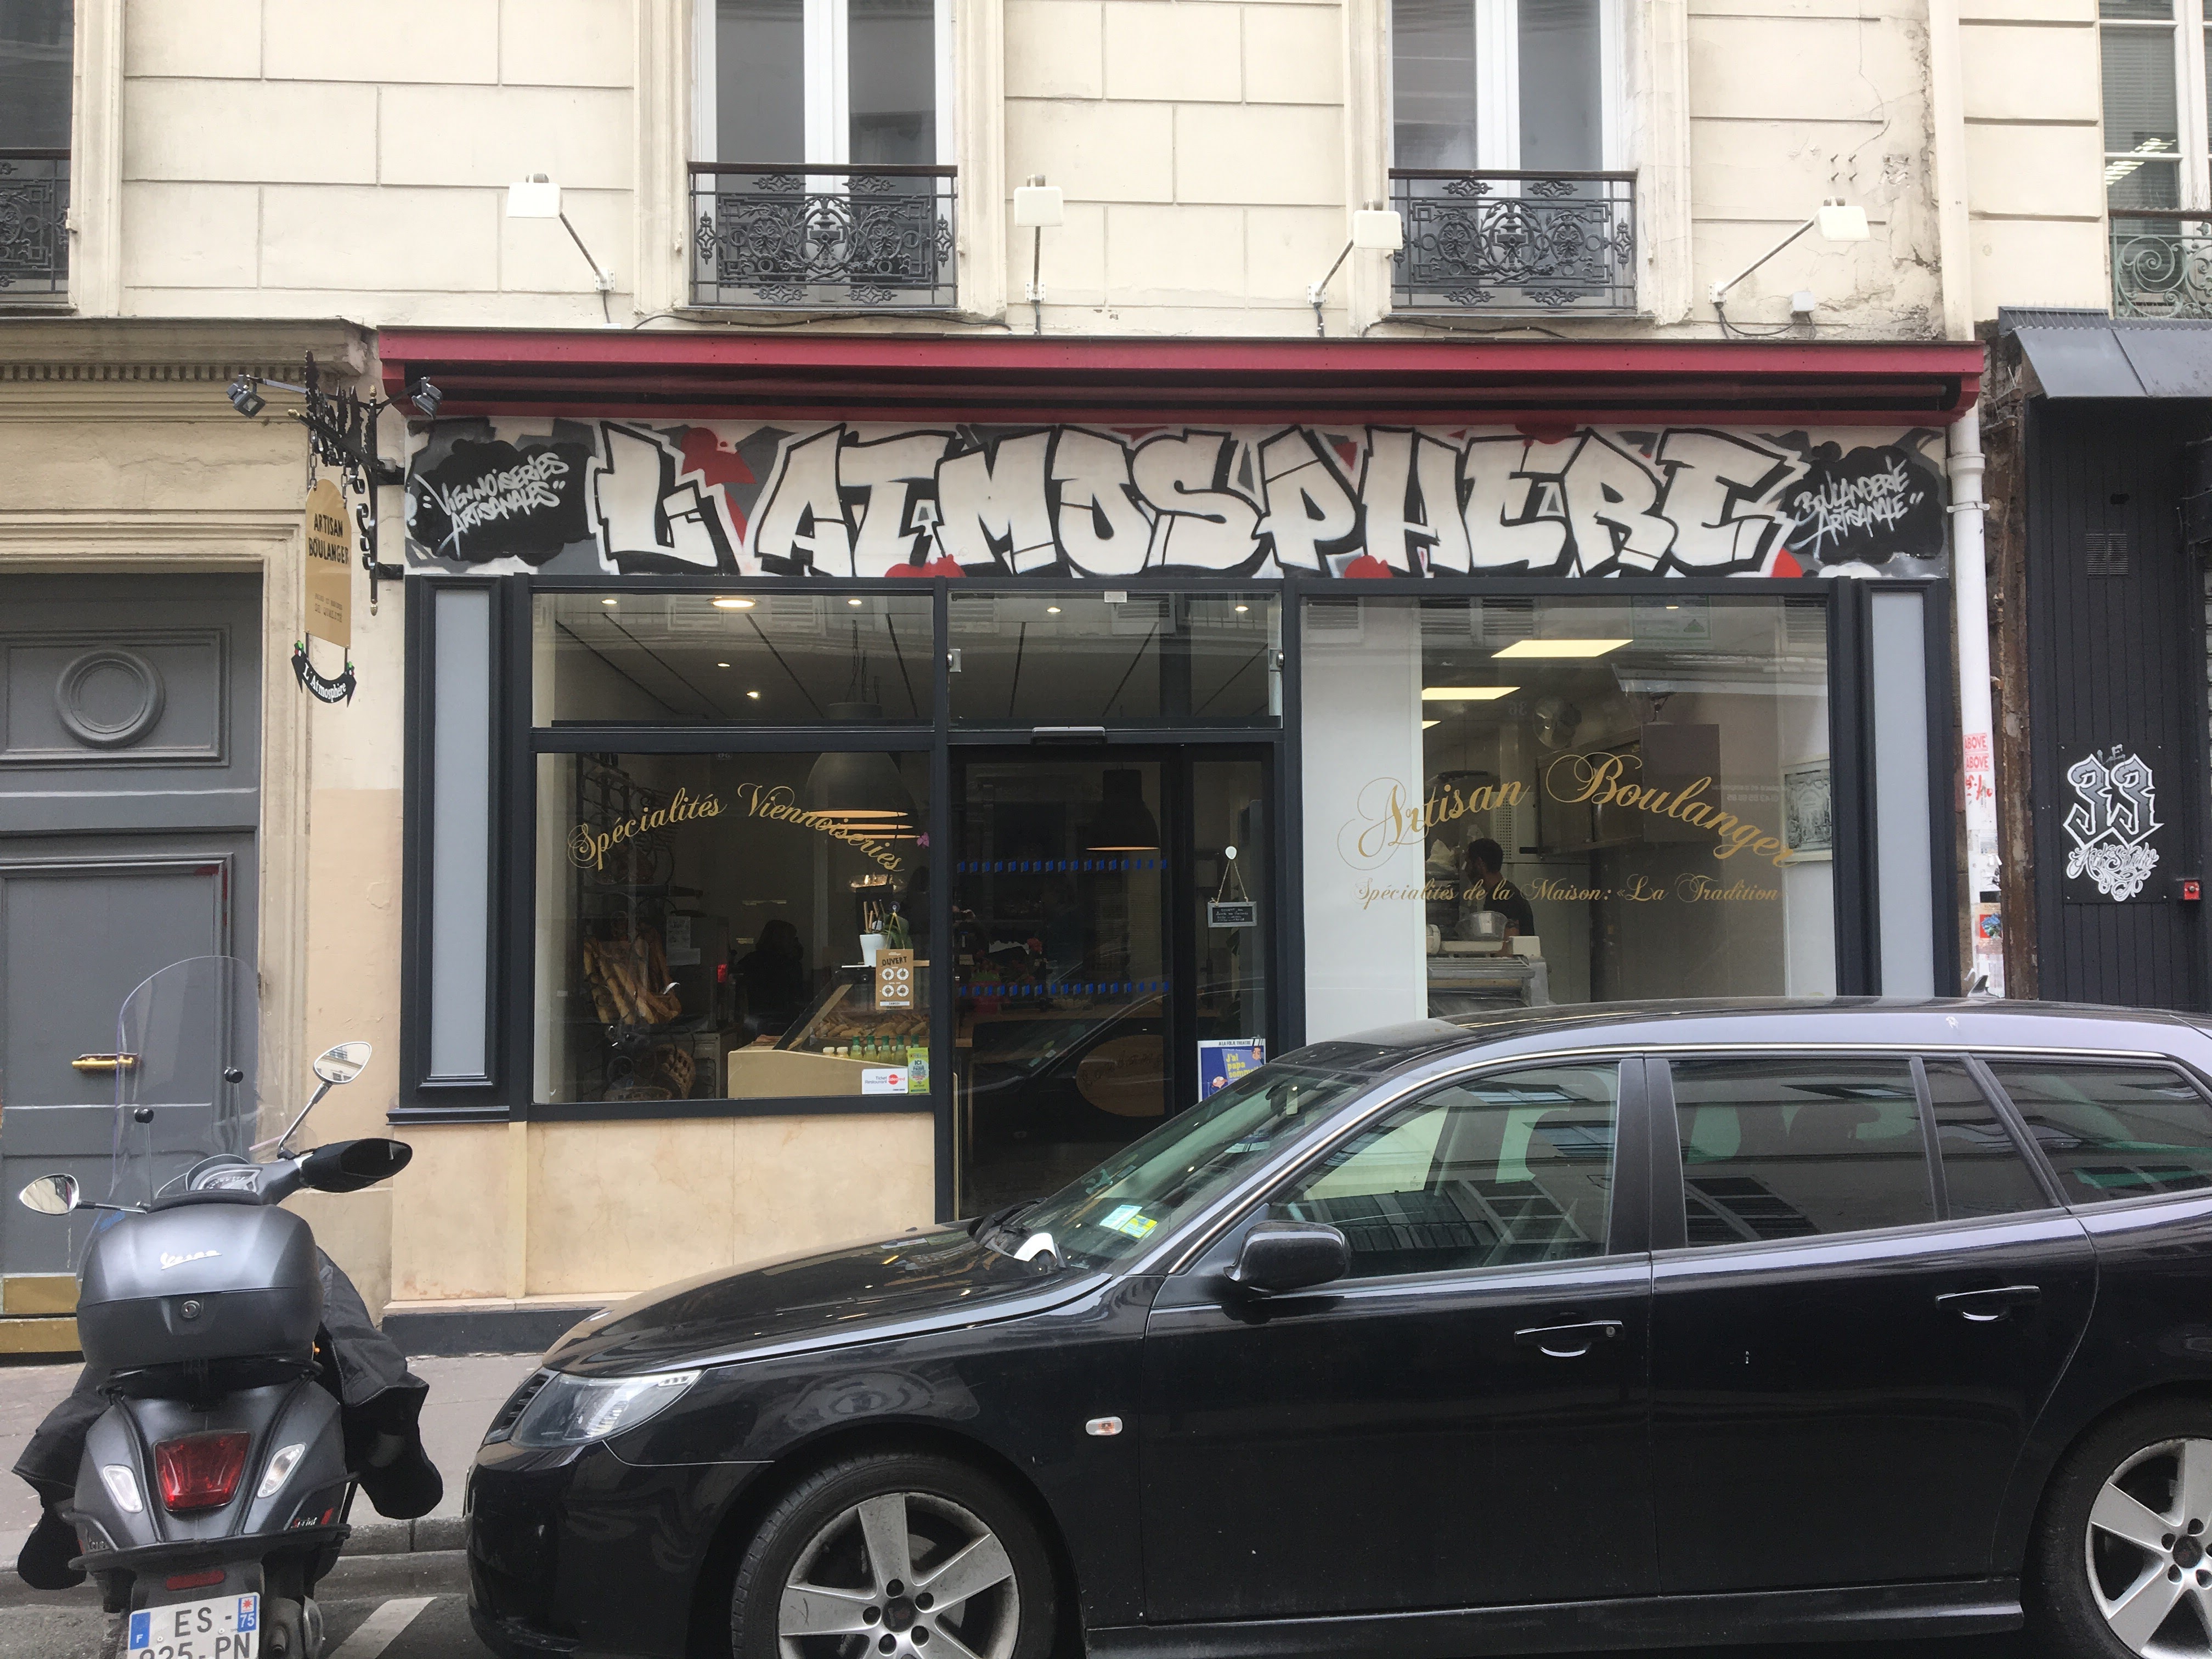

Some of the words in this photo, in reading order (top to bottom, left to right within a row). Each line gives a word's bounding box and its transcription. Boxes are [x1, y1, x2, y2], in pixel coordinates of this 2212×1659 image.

[314, 513, 343, 538] ARTISAN
[308, 537, 349, 565] BOULANGER
[1337, 775, 1531, 871] Artisan
[1546, 752, 1797, 868] Boulanger
[567, 787, 727, 872] Spécialités
[737, 783, 905, 872] Viennoiseries
[1352, 876, 1458, 910] Spécialités
[1463, 879, 1487, 900] de
[1492, 878, 1514, 900] la
[1674, 873, 1779, 902] Tradition
[882, 956, 907, 966] OUVERT
[1227, 1062, 1245, 1071] papa
[240, 1613, 255, 1628] 75
[136, 1634, 144, 1644] F
